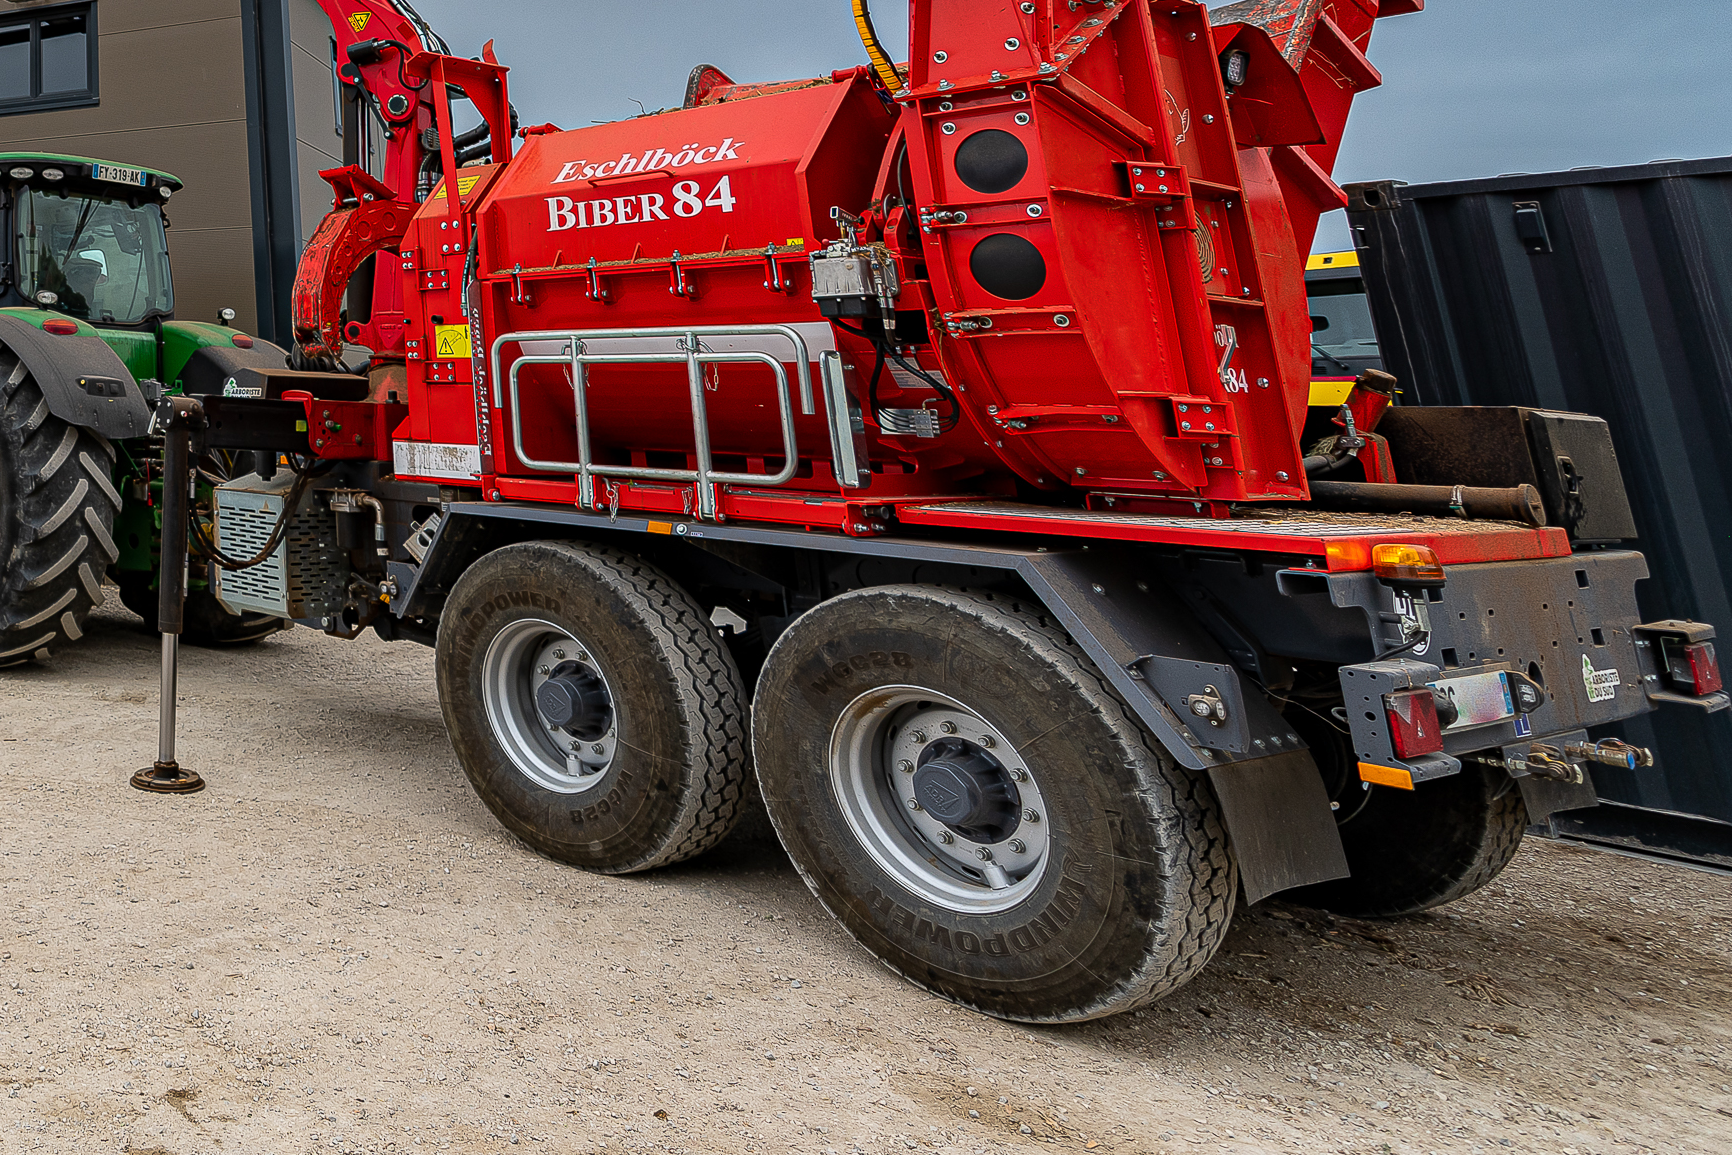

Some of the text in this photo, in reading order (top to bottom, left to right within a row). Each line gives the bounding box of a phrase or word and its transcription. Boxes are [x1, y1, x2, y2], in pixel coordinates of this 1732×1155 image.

[99, 166, 140, 183] FY-319-AK
[550, 138, 745, 184] Eschlböck
[544, 175, 737, 232] BIBER 84
[865, 874, 1087, 957] WINDPOWER
